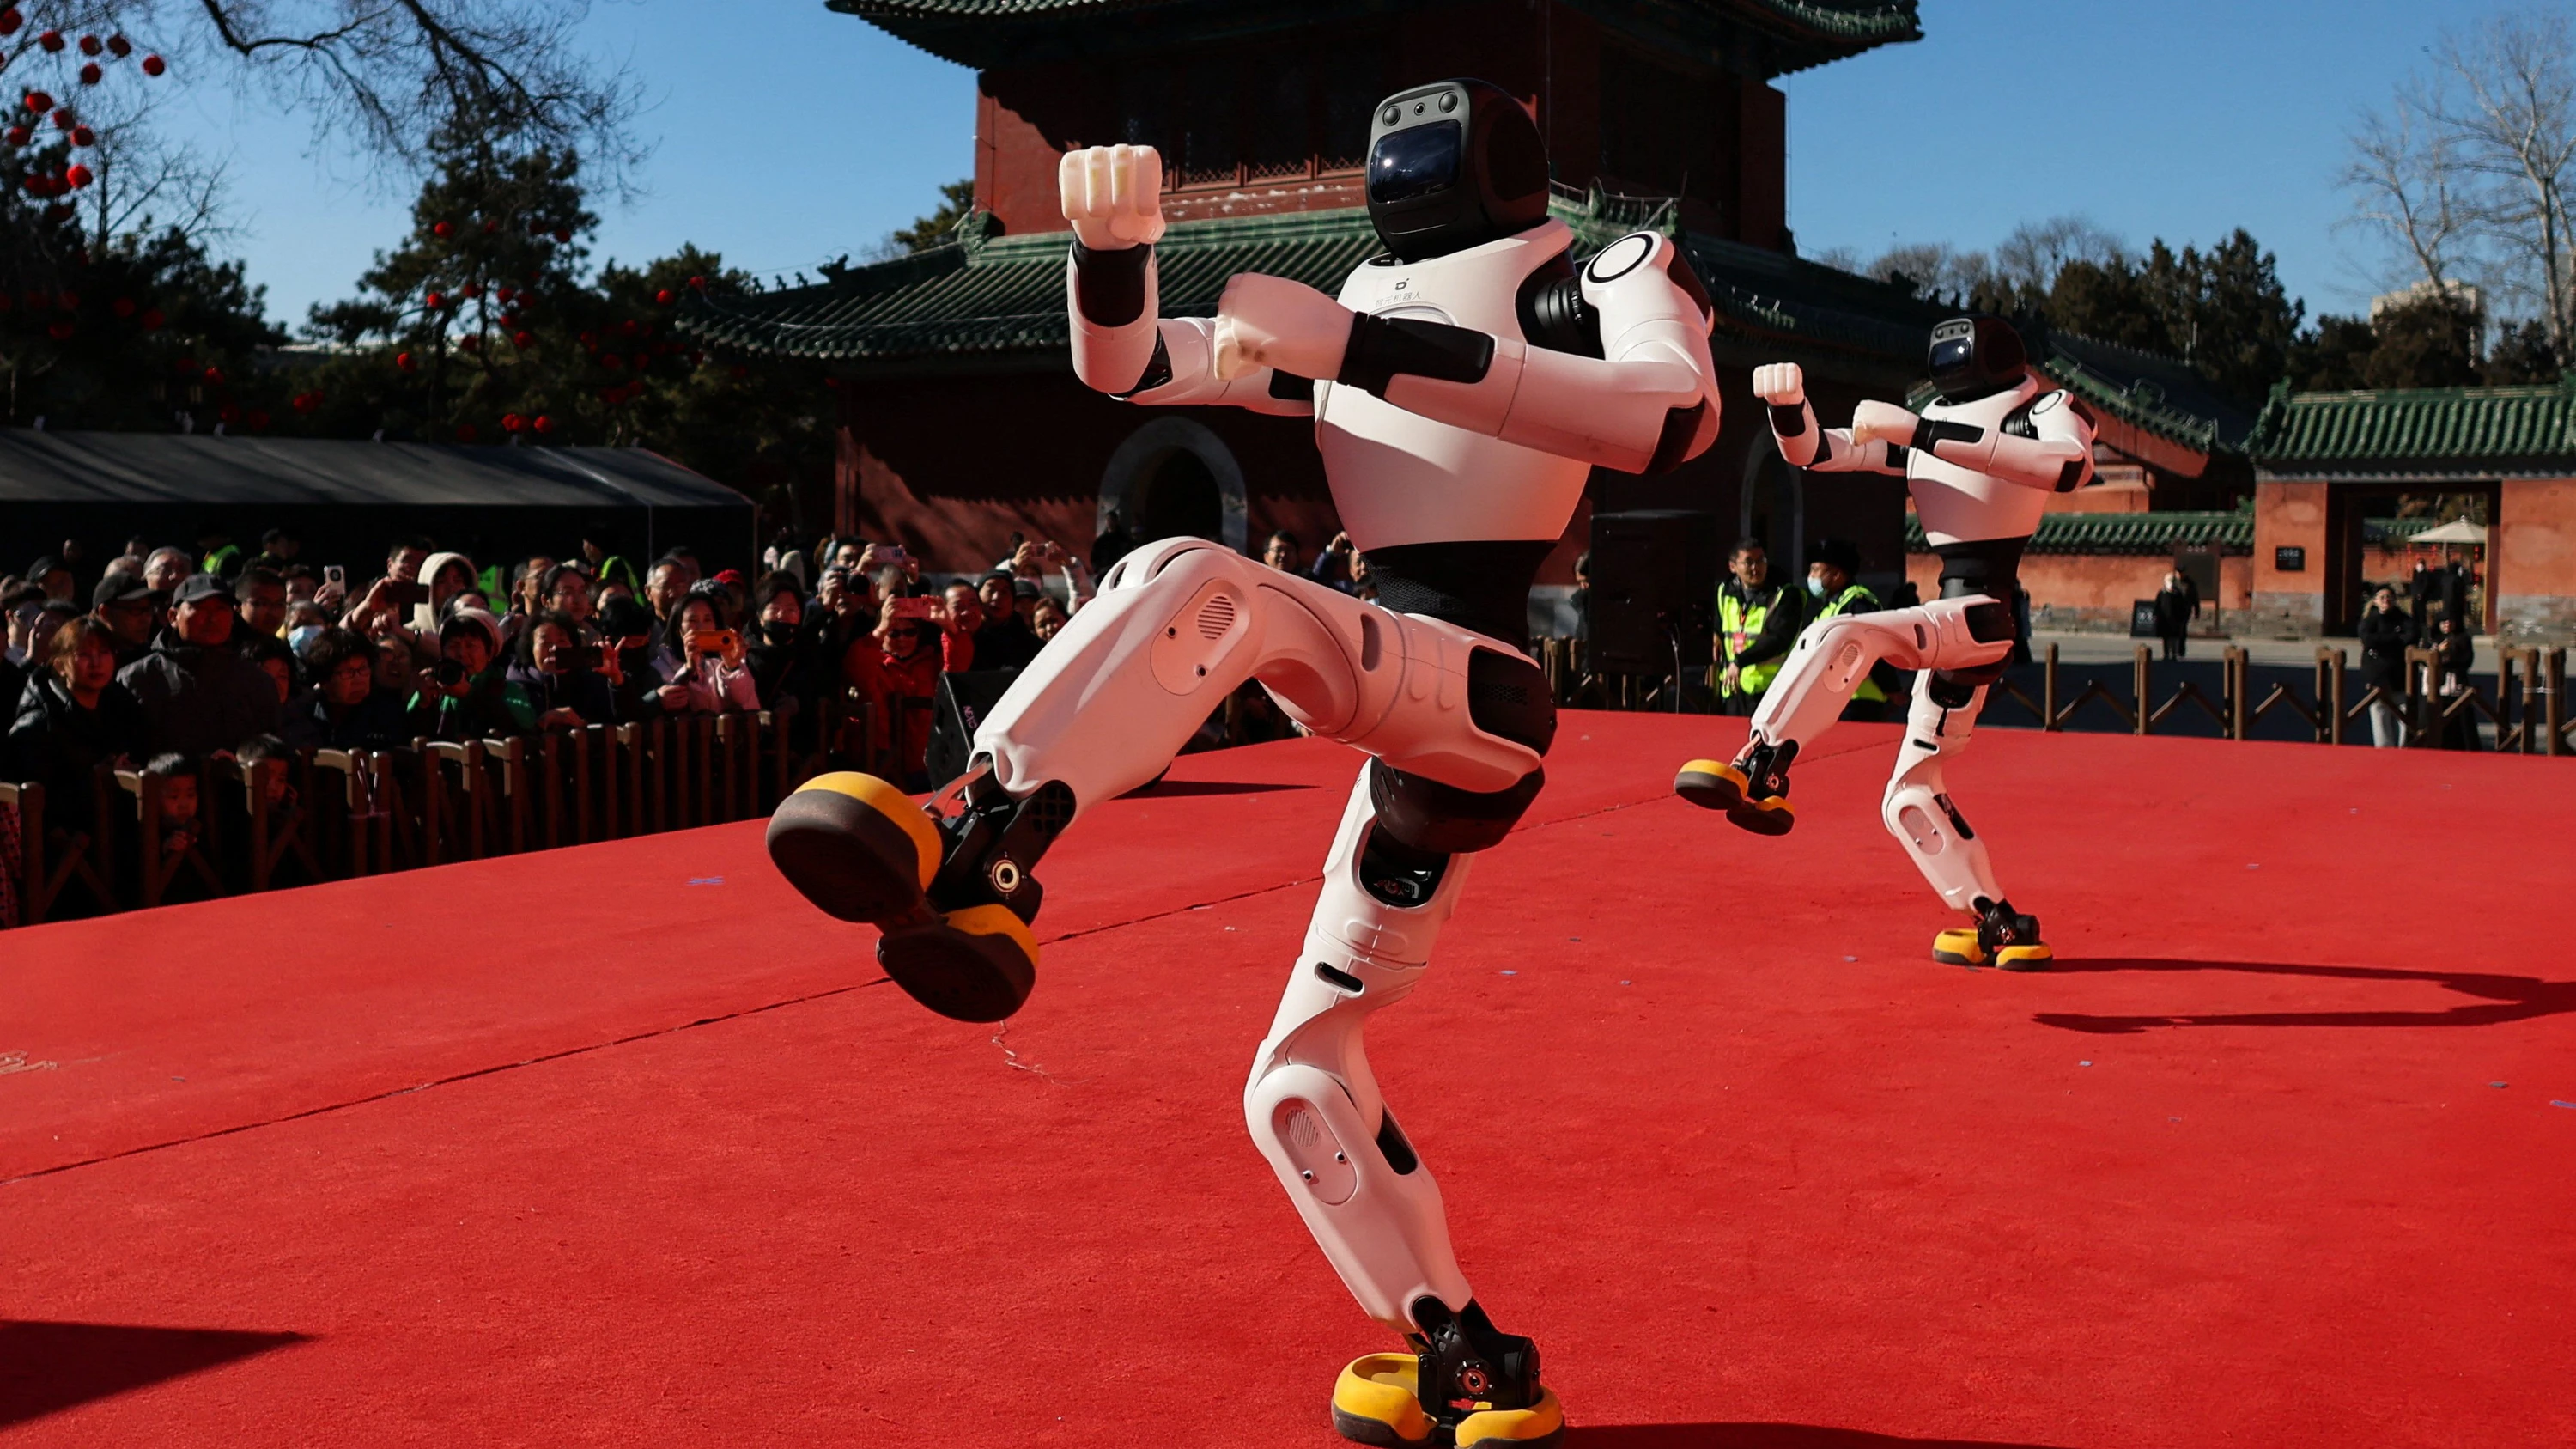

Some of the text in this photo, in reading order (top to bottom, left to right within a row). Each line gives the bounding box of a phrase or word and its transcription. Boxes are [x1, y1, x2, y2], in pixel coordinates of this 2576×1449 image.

[1376, 291, 1421, 307] 智元机器人
